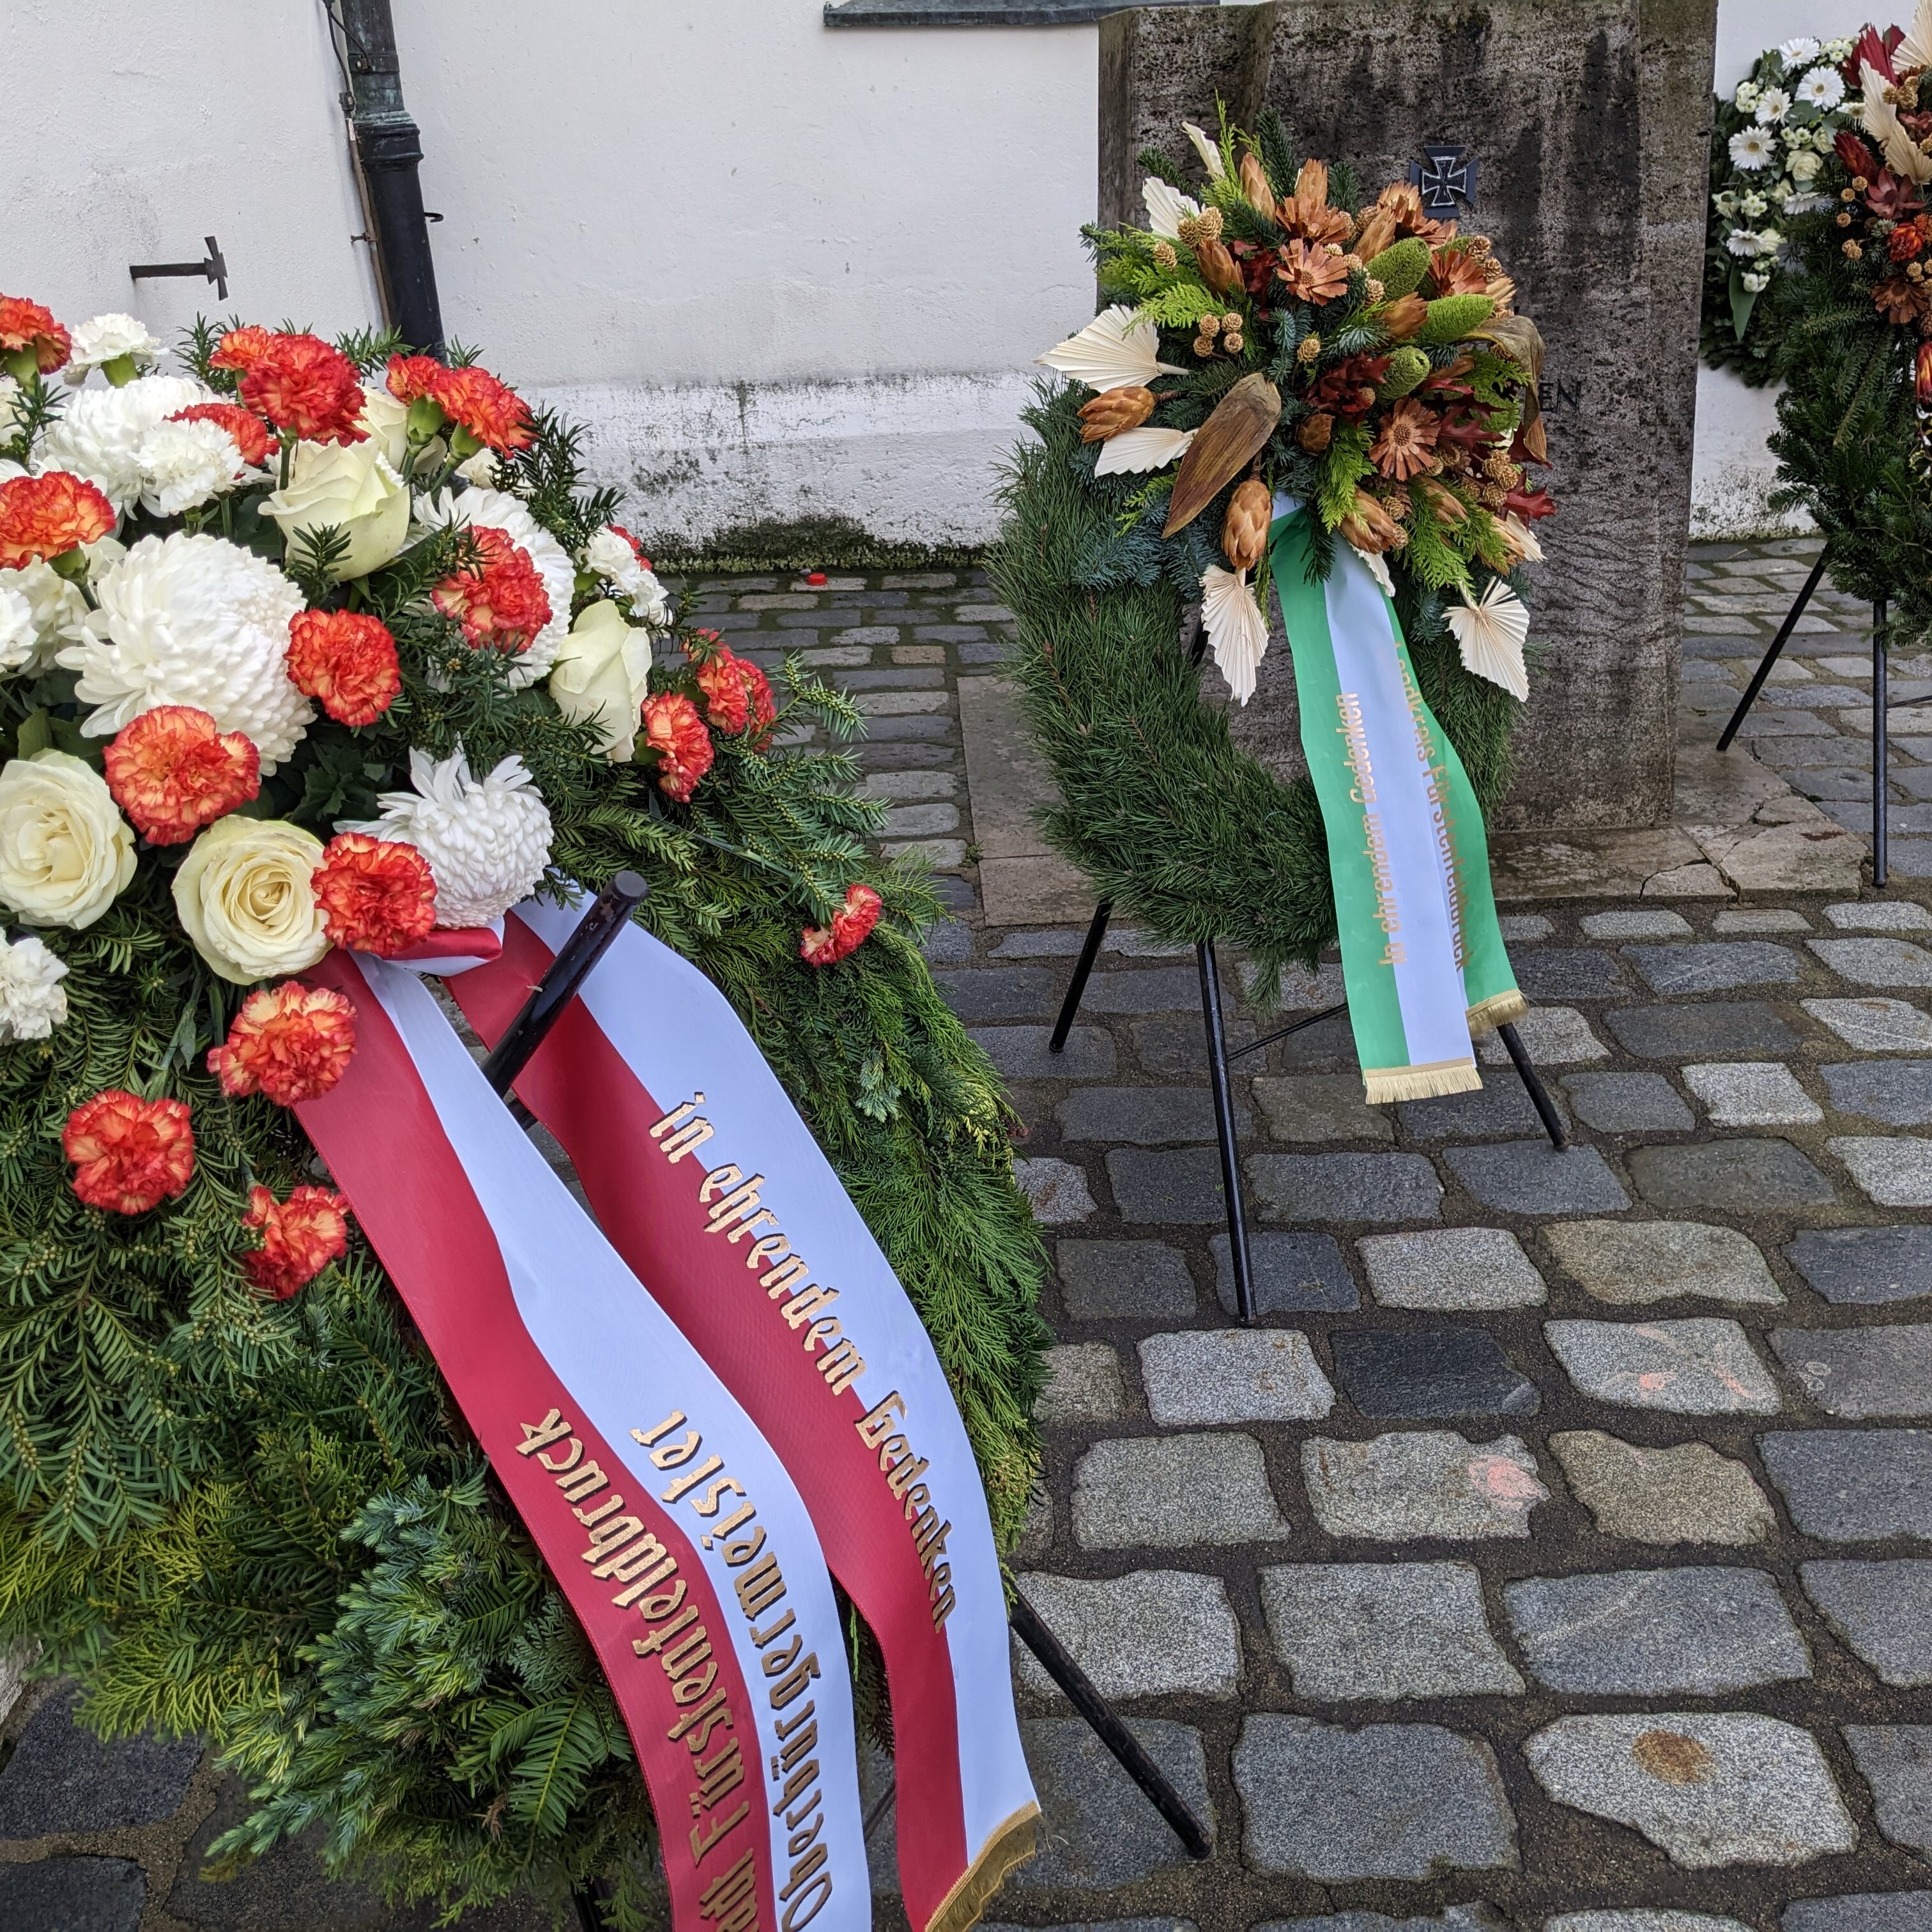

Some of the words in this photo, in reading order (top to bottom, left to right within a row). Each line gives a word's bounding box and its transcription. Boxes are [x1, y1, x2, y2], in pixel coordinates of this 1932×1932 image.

[1335, 693, 1377, 804] Gedenken
[1362, 813, 1401, 933] ehrendem
[1395, 641, 1436, 762] ndkreis
[1422, 764, 1473, 972] Fürstenfeldbruck
[1378, 944, 1407, 965] In
[648, 1091, 716, 1165] in
[698, 1162, 868, 1396] ehrendem
[855, 1389, 957, 1635] Gedenken
[515, 1408, 750, 1868] Fürstenfeldbruck
[629, 1409, 833, 1932] Oberbürgermeister
